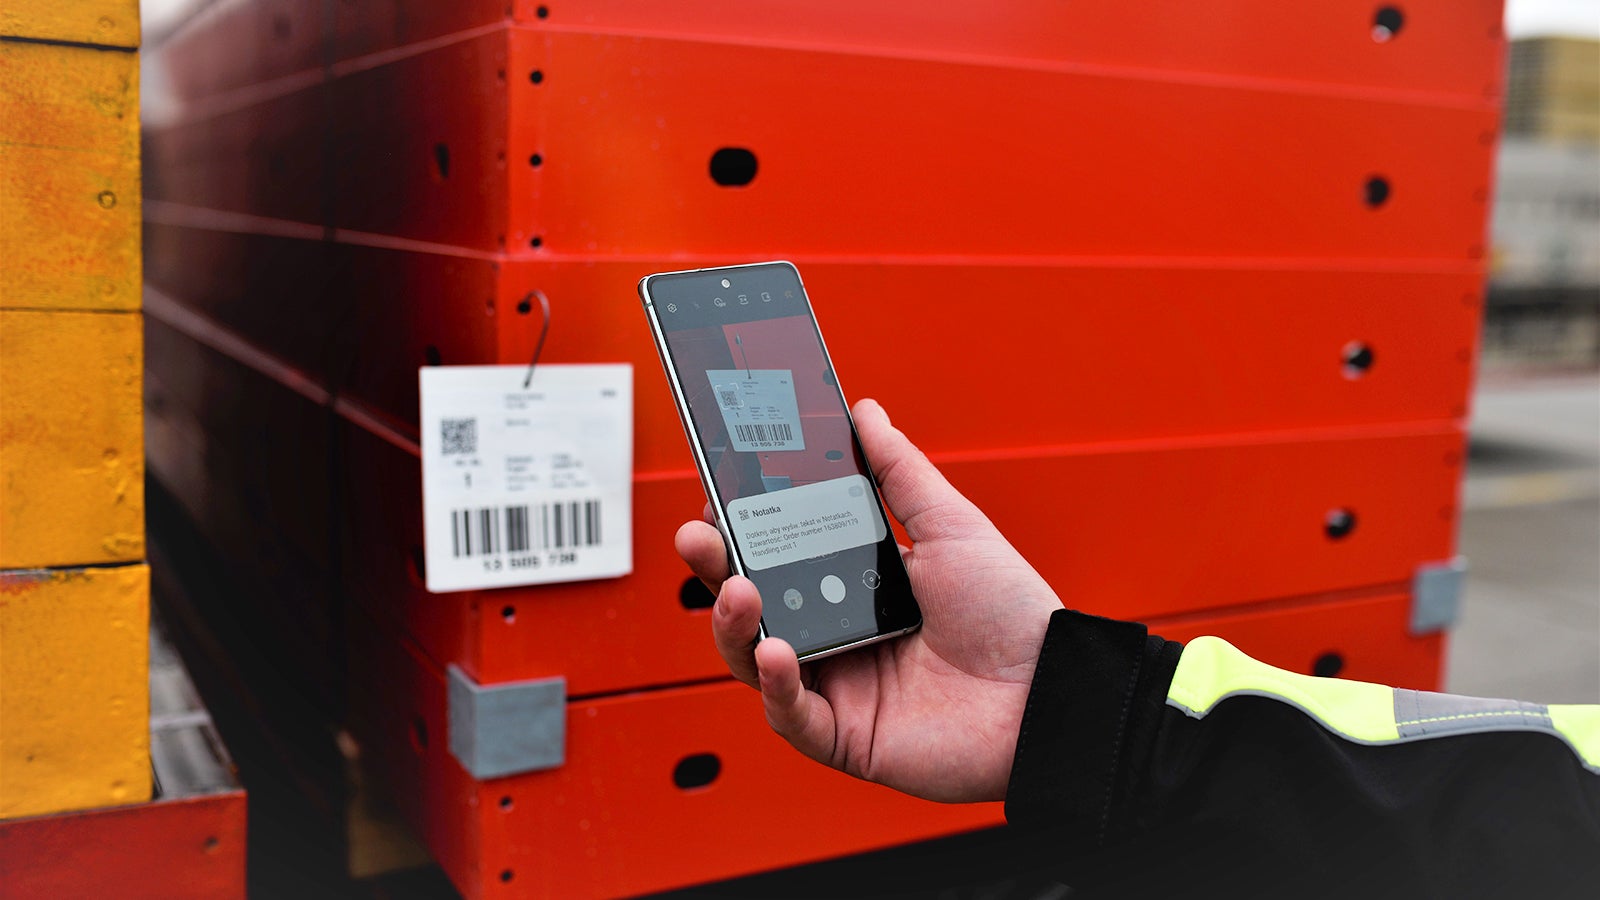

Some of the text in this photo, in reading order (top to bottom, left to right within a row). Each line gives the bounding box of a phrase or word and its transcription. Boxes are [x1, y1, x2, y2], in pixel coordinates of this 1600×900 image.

[752, 506, 781, 518] Notatka
[769, 527, 780, 535] aby
[800, 519, 815, 527] tekst
[783, 532, 799, 541] Order
[800, 527, 823, 537] number
[752, 546, 780, 557] Handling
[780, 543, 792, 551] unit
